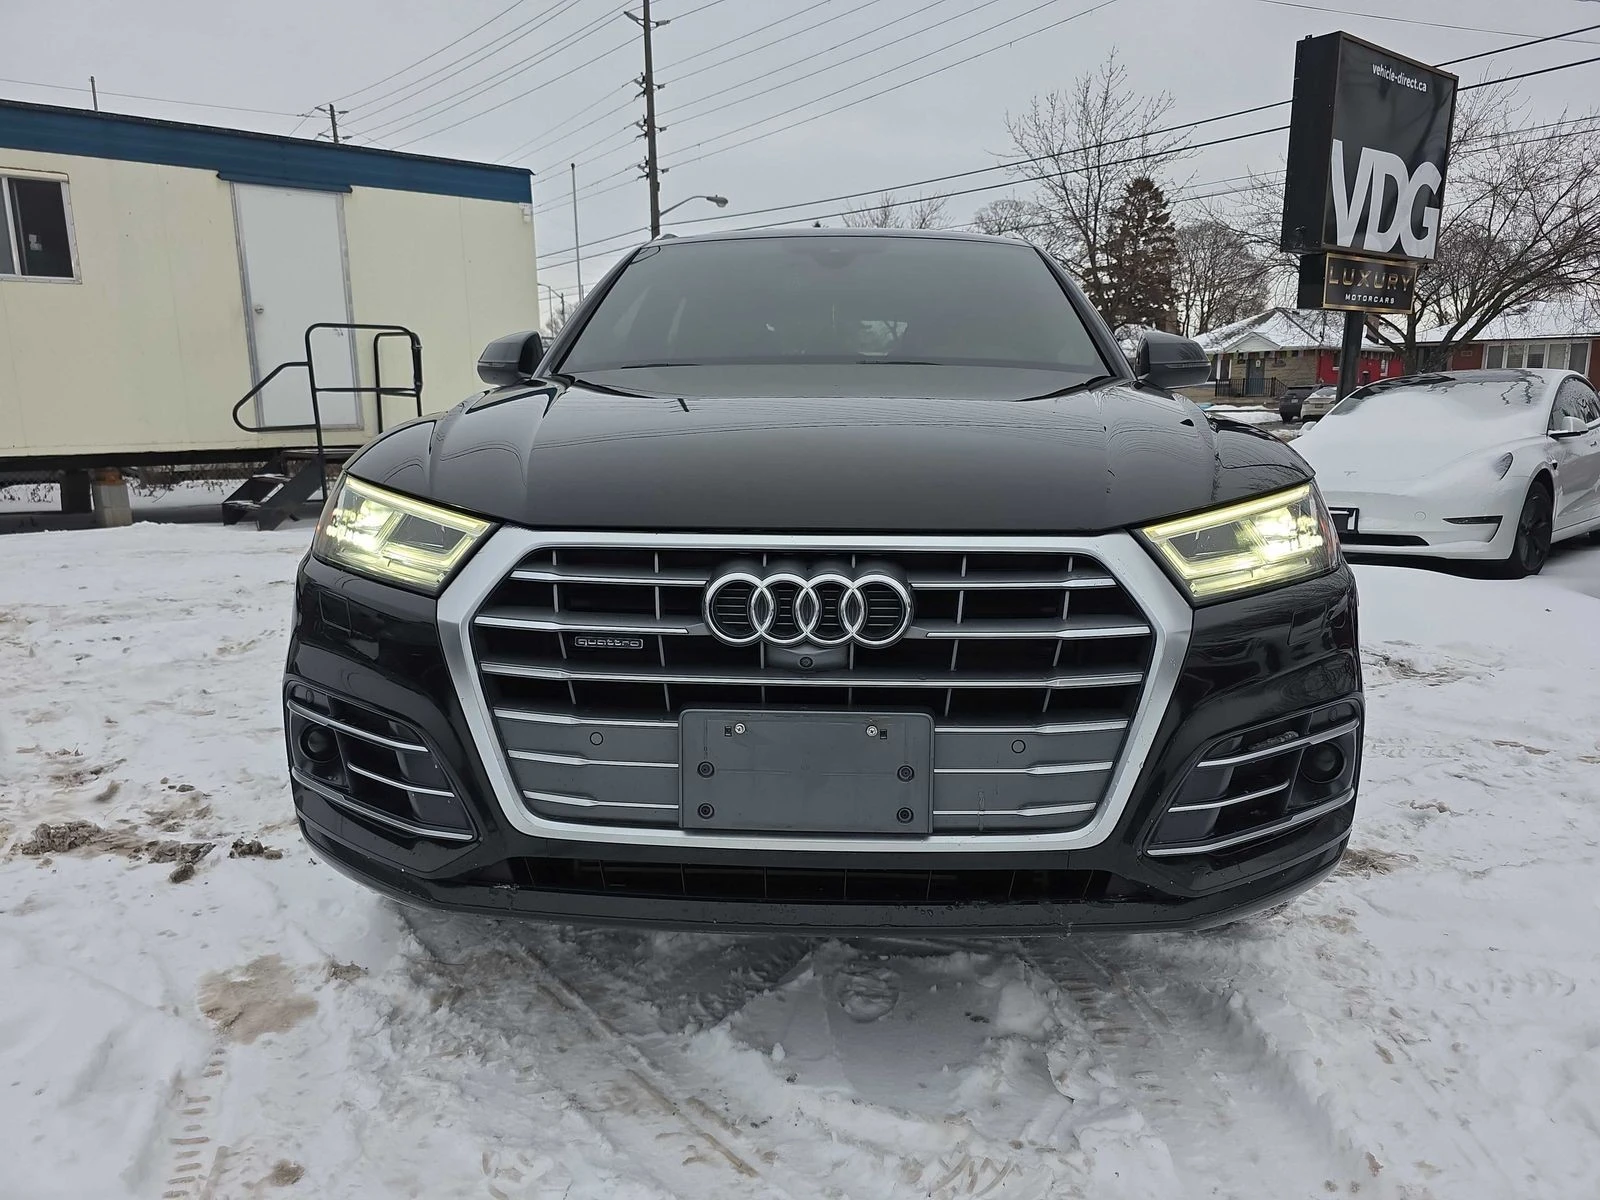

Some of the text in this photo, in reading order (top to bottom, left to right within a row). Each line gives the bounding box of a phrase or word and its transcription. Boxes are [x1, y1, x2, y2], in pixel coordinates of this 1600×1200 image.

[1372, 63, 1427, 92] vehicle-direct.ca
[1331, 138, 1442, 259] VDG
[1328, 266, 1413, 291] LUXURY
[1345, 293, 1395, 304] MOTORCARS
[577, 638, 640, 647] quattro
